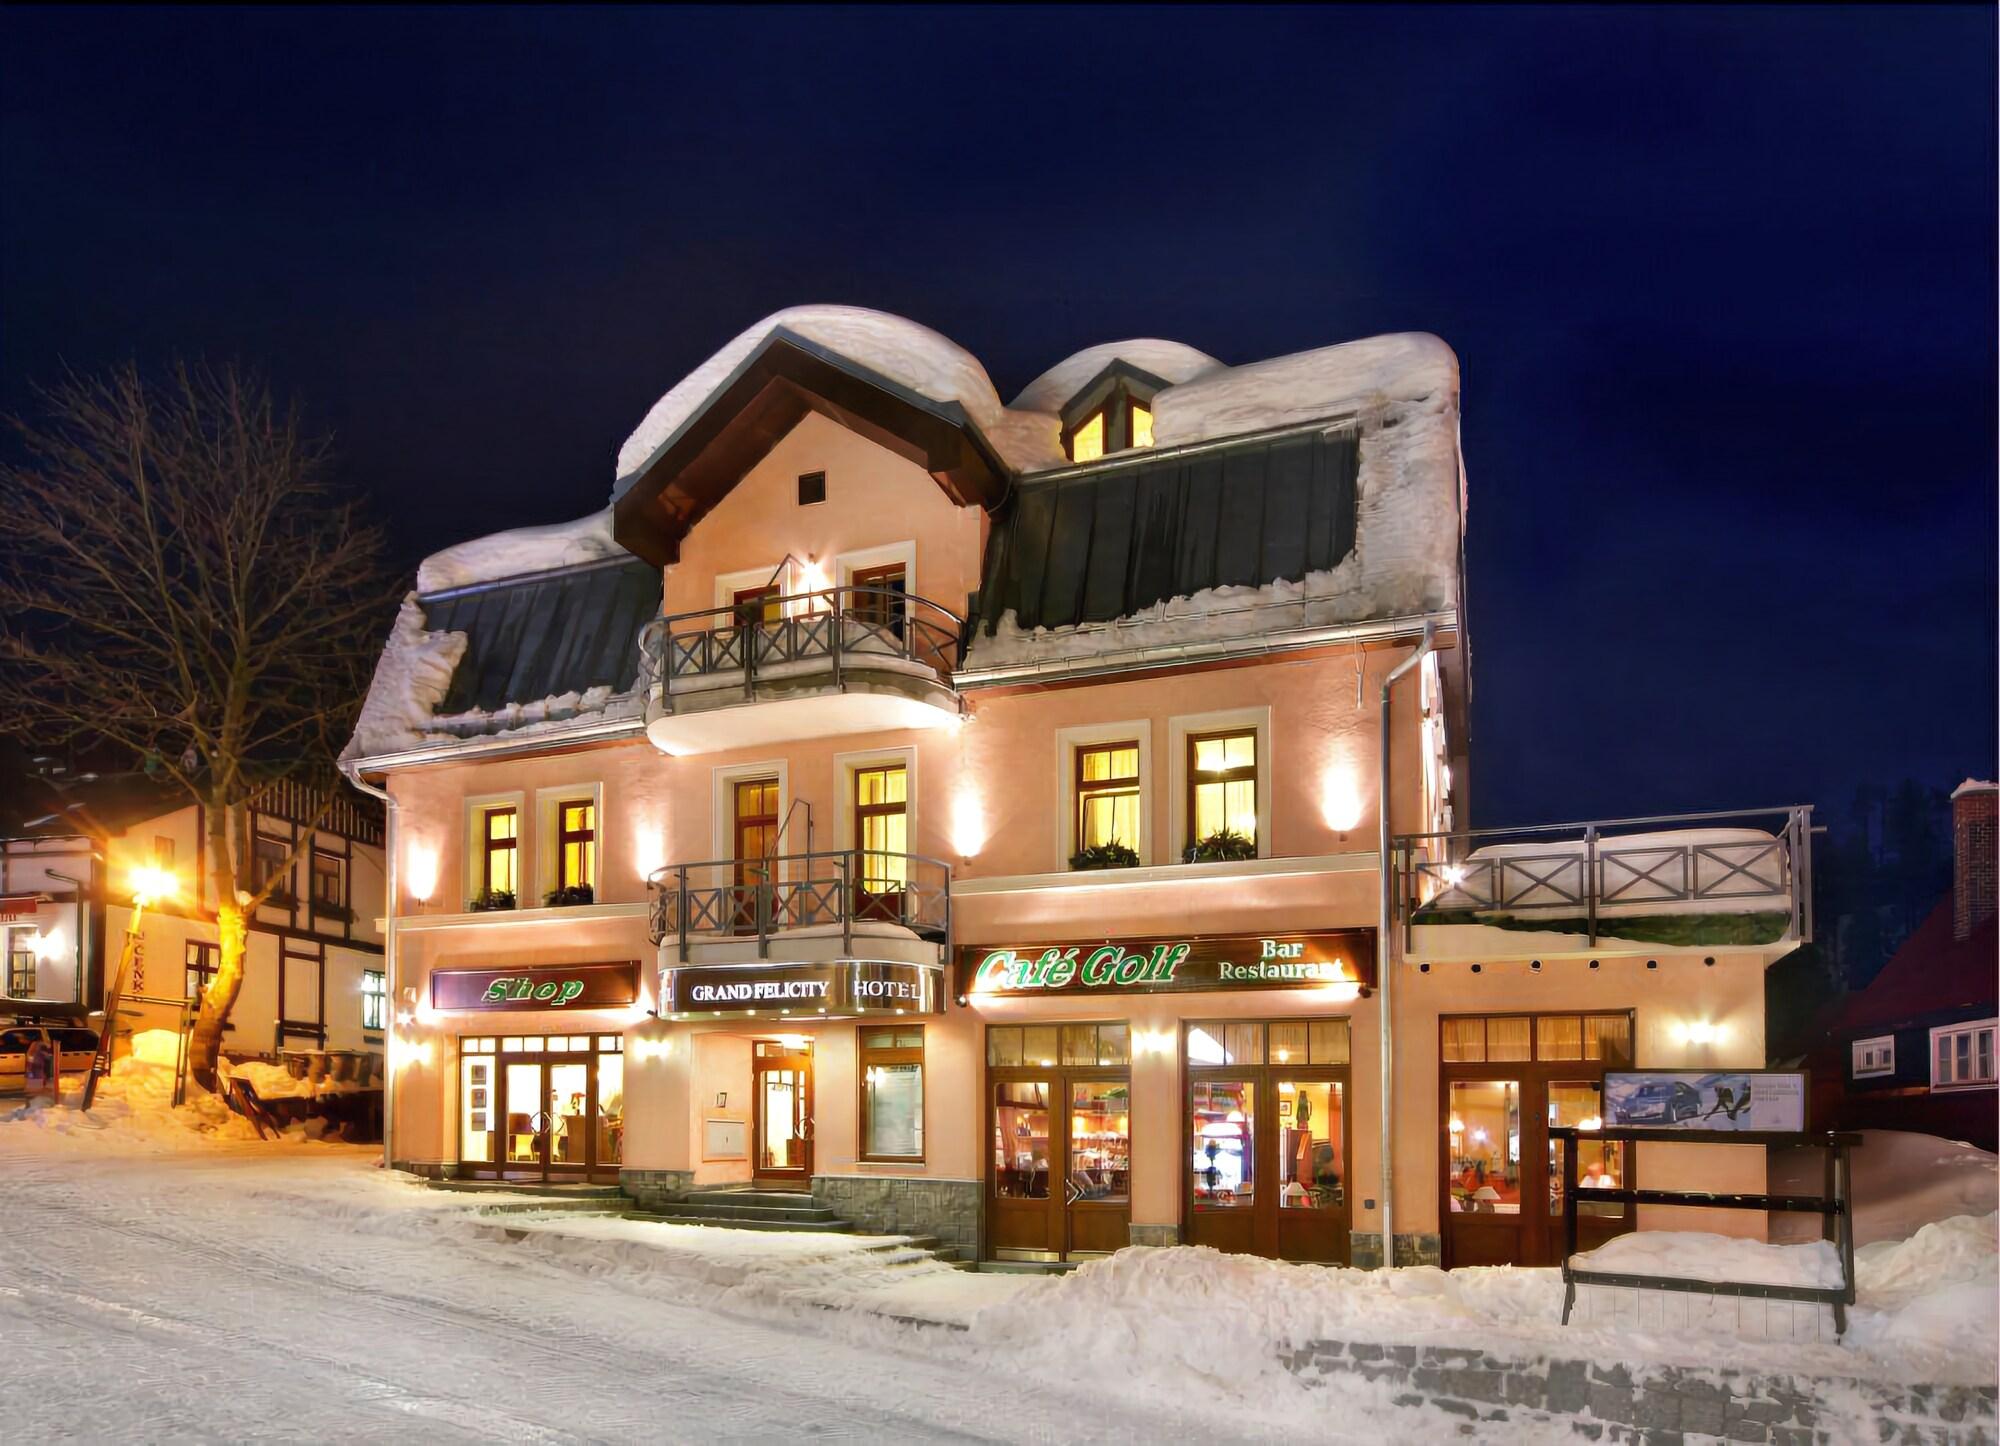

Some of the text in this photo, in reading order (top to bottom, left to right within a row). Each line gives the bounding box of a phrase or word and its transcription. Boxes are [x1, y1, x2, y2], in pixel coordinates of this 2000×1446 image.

[1260, 939, 1304, 958] Bar
[975, 944, 1190, 988] Café Golf
[1218, 958, 1345, 980] Restaurant
[481, 978, 584, 1005] Shop
[692, 984, 753, 1001] GRAND
[755, 981, 830, 999] FELICITY
[853, 980, 921, 999] HOTEL
